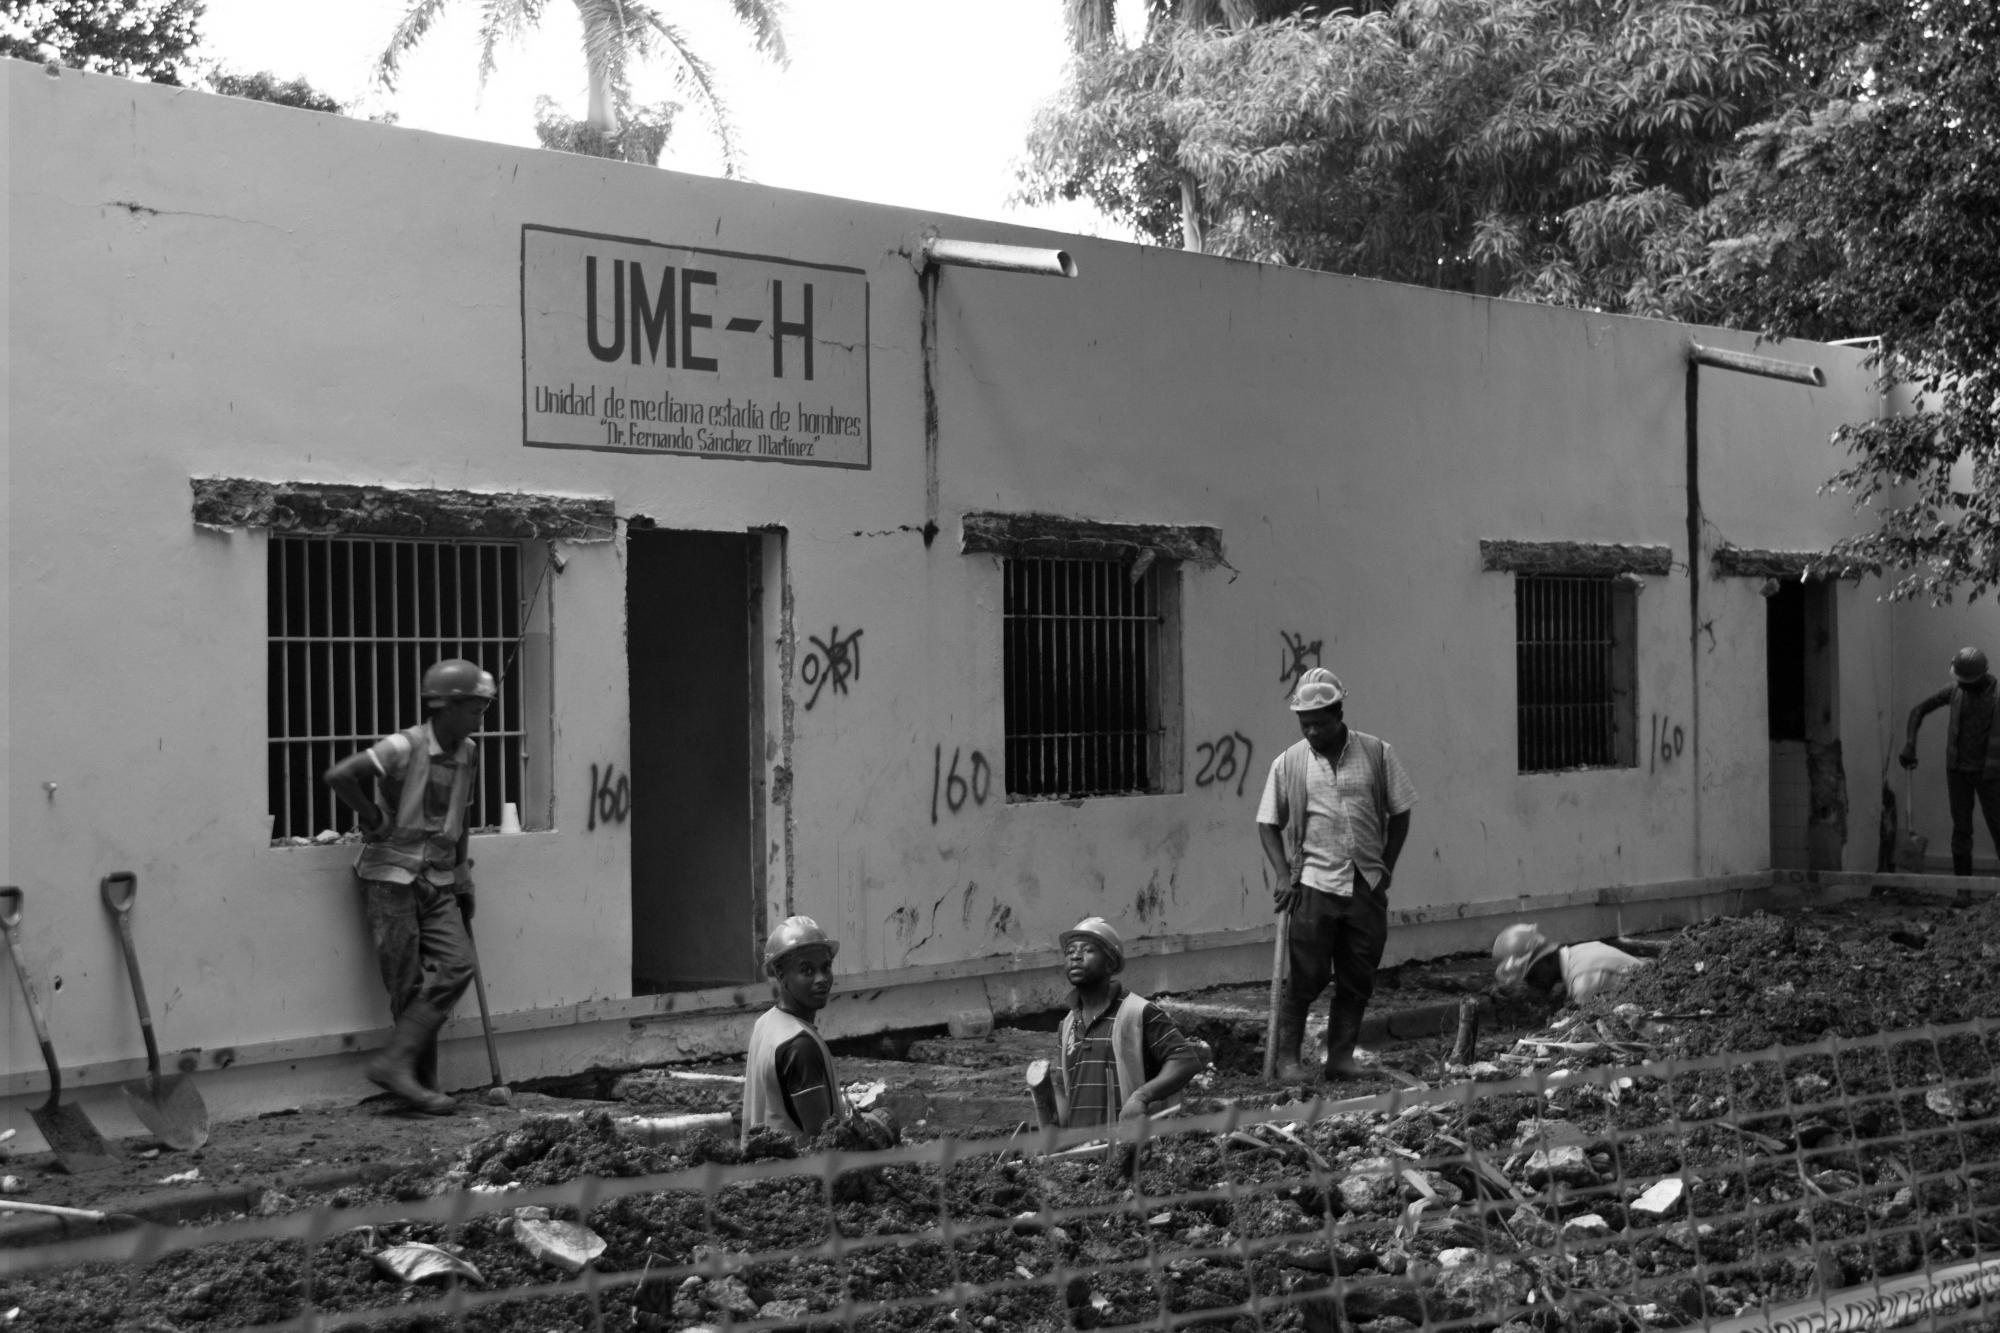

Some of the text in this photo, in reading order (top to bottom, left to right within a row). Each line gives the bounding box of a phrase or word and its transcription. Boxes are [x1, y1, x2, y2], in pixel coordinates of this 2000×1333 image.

[586, 255, 814, 381] UME-H
[535, 382, 860, 437] Unidad de mediana estadía de hombres
[629, 422, 694, 450] Fernando
[697, 427, 752, 454] Sánchez
[1650, 712, 1684, 776] 160
[588, 762, 630, 832] 160
[930, 743, 991, 825] 160
